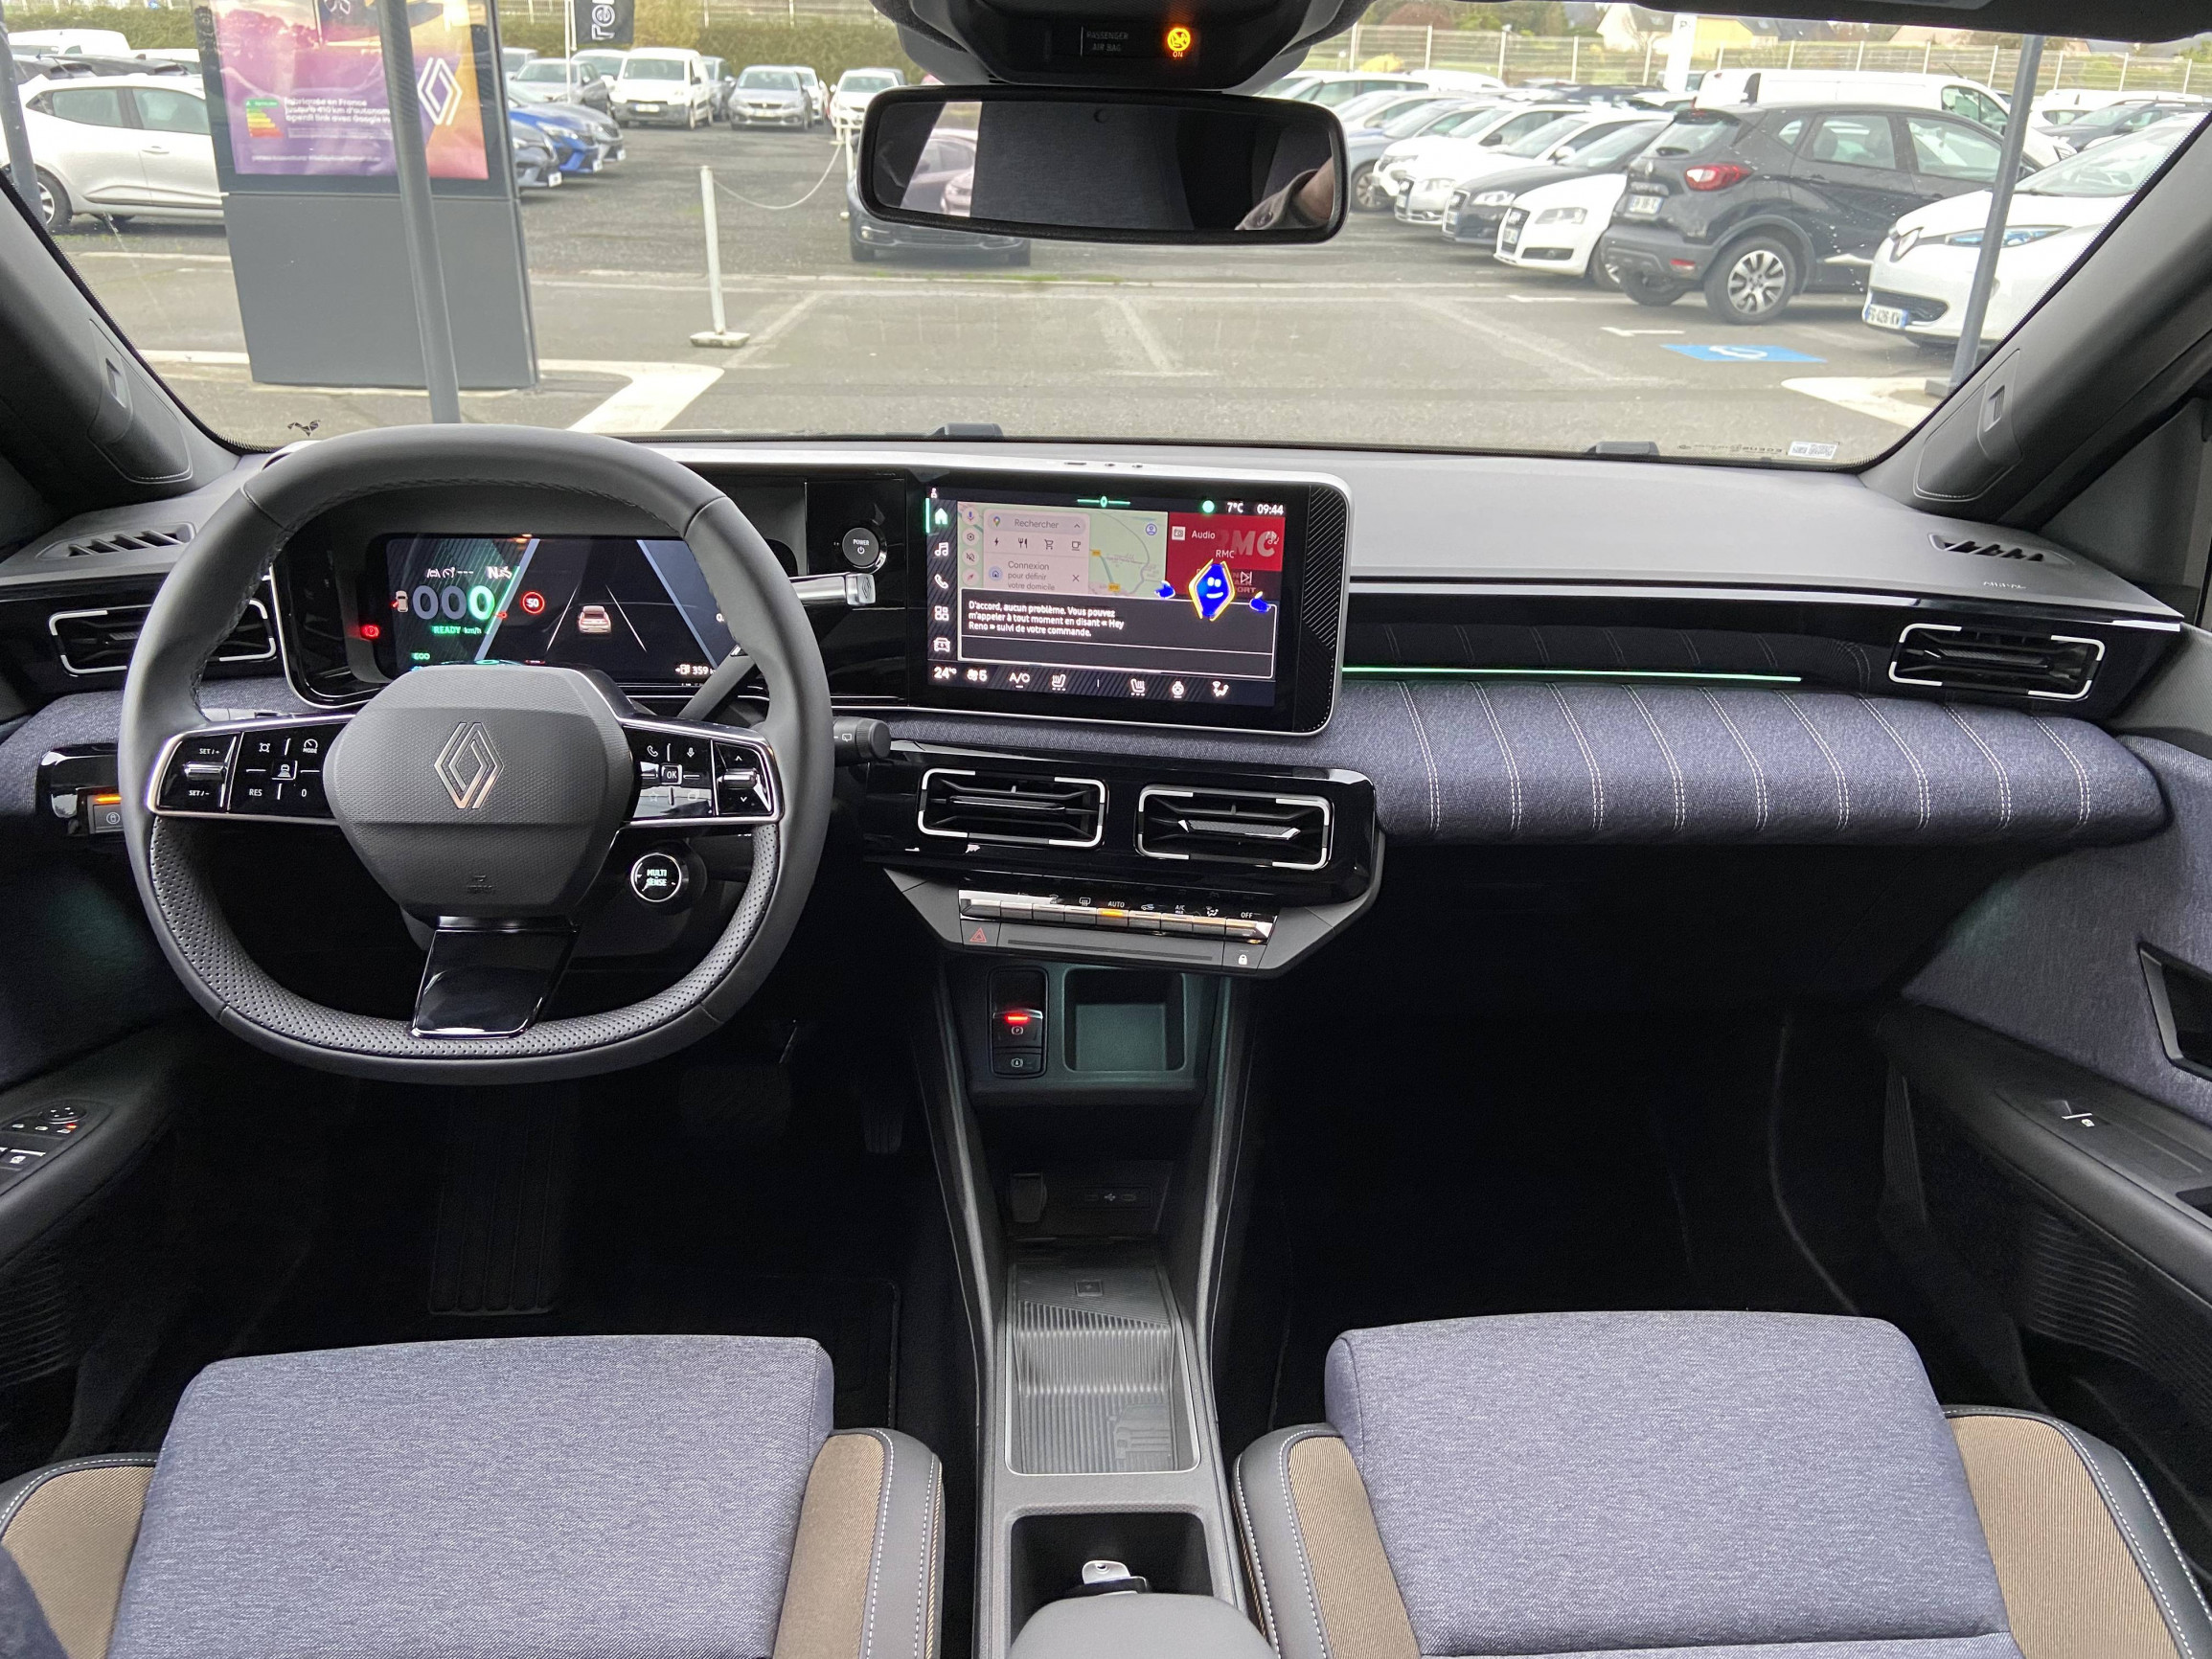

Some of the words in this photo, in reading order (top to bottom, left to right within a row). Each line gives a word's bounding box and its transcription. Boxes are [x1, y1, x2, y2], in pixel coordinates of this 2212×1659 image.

[1227, 502, 1243, 512] 7°C
[1257, 504, 1284, 515] 09:44
[1015, 518, 1060, 529] Rechercher
[1191, 530, 1216, 540] Audio
[1216, 549, 1235, 558] RMC
[1008, 560, 1050, 571] Connexion
[1025, 572, 1047, 580] définir
[1028, 582, 1056, 591] domicile
[969, 601, 1003, 612] D'accord,
[1003, 603, 1028, 612] aucun
[1028, 603, 1067, 616] problème.
[1067, 606, 1086, 616] Vous
[1087, 608, 1115, 619] pouvez
[969, 611, 1006, 623] m'appeler
[1013, 614, 1030, 623] tout
[1031, 616, 1064, 625] moment
[1076, 617, 1101, 627] disant
[1108, 619, 1125, 630] Hey
[433, 625, 462, 634] READY
[969, 622, 989, 631] Reno
[996, 623, 1015, 632] suivi
[1015, 624, 1025, 633] de
[1026, 625, 1047, 634] votre
[1047, 627, 1092, 637] commande.
[692, 666, 709, 675] 359
[667, 770, 677, 779] OK
[647, 869, 668, 877] MULTI
[647, 878, 668, 887] SENSE
